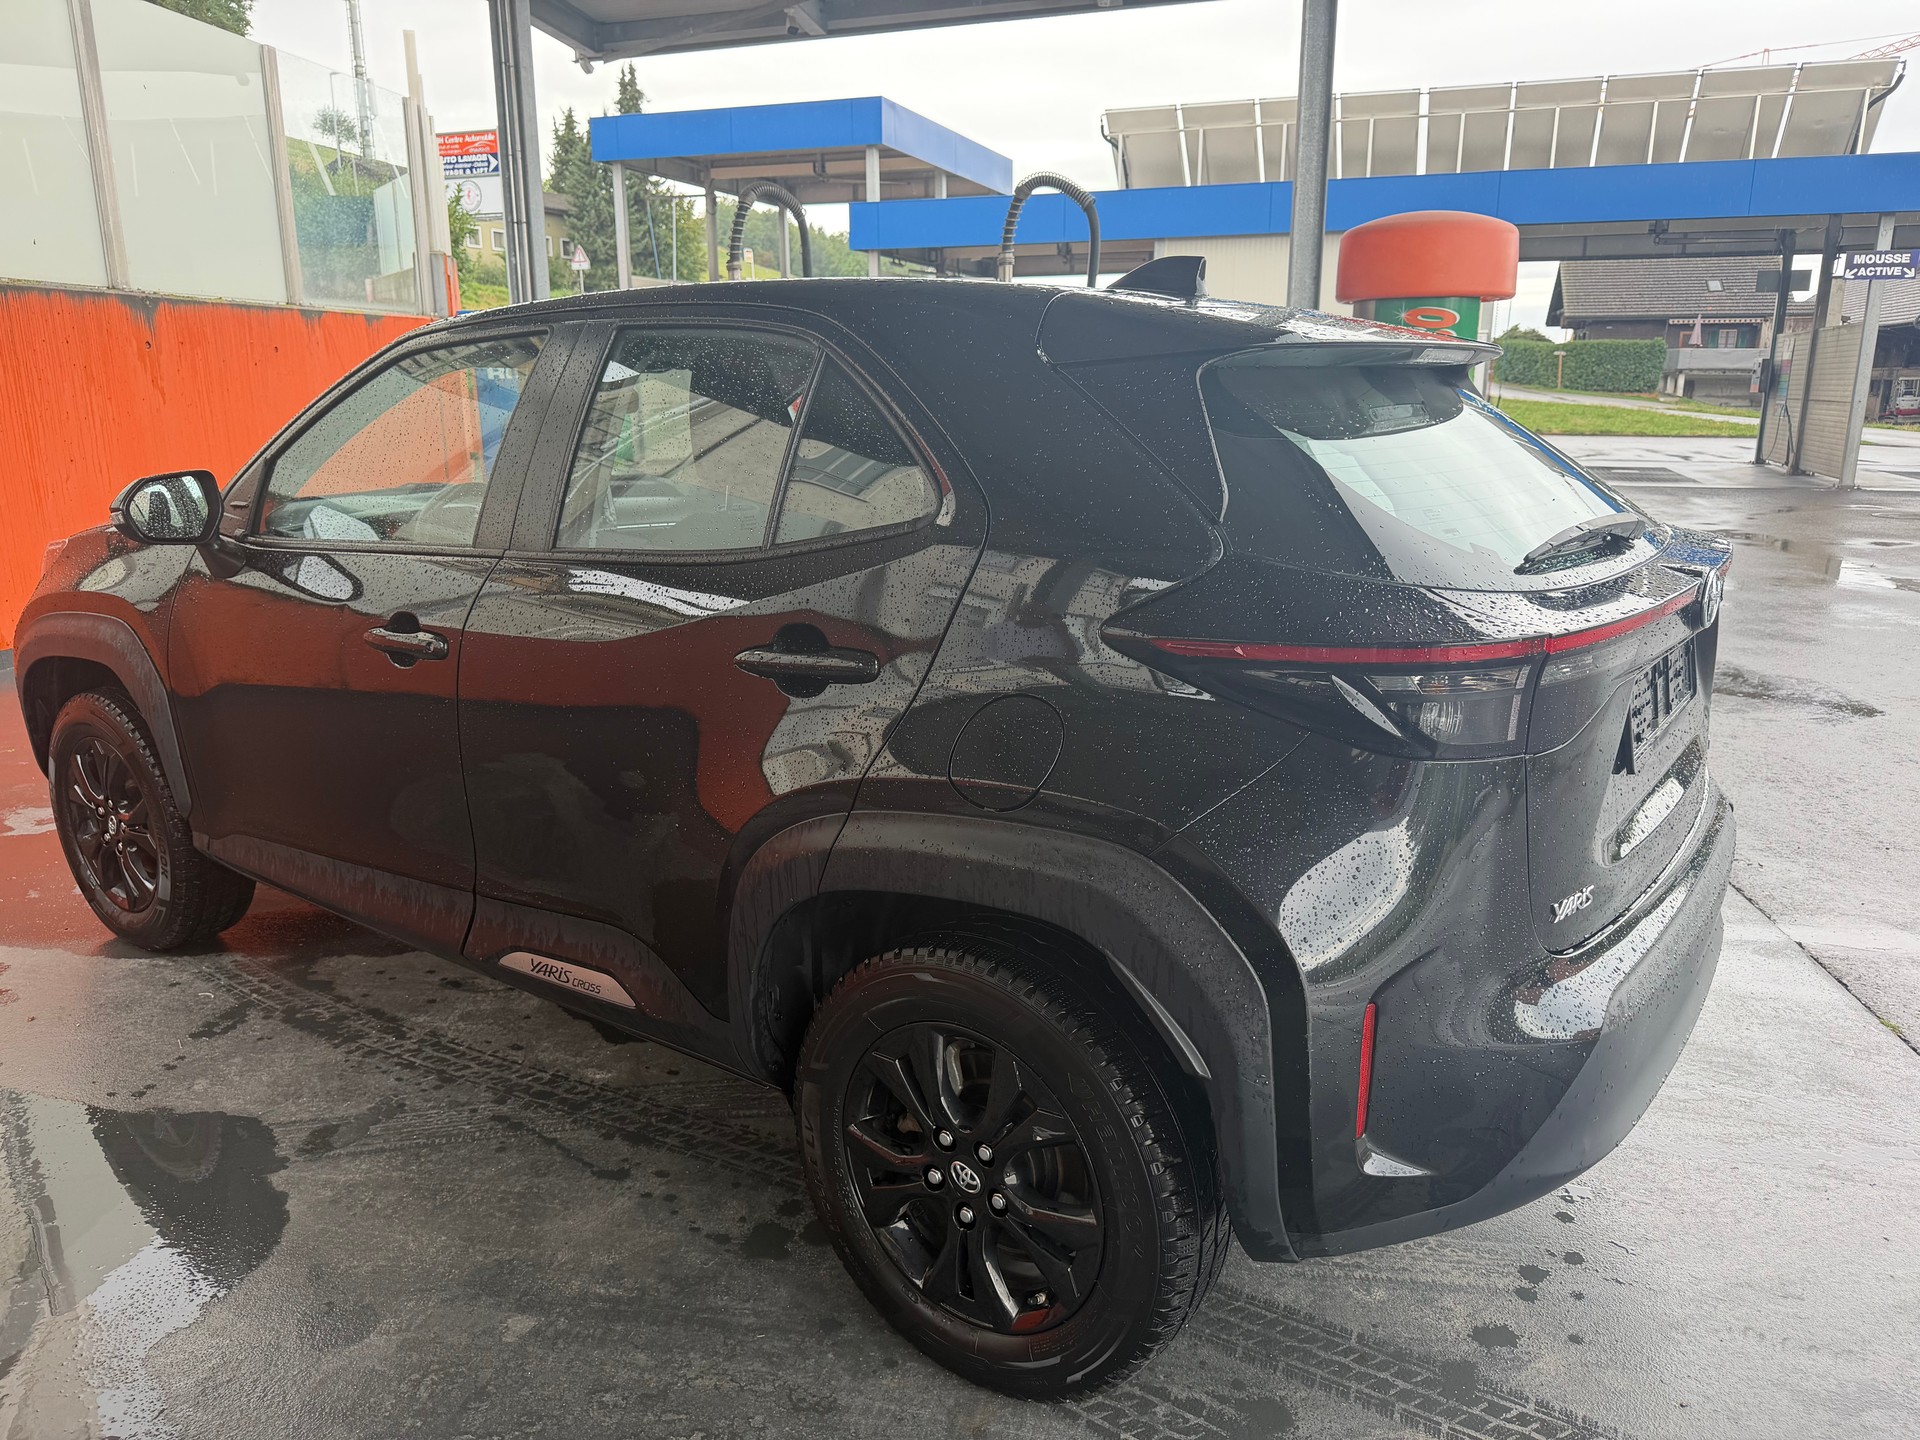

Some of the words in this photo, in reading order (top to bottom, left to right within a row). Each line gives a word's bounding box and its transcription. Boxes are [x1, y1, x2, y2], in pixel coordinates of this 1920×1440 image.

[1853, 253, 1911, 264] MOUSSE
[1857, 266, 1902, 276] ACTIVE
[572, 977, 602, 995] CROSS
